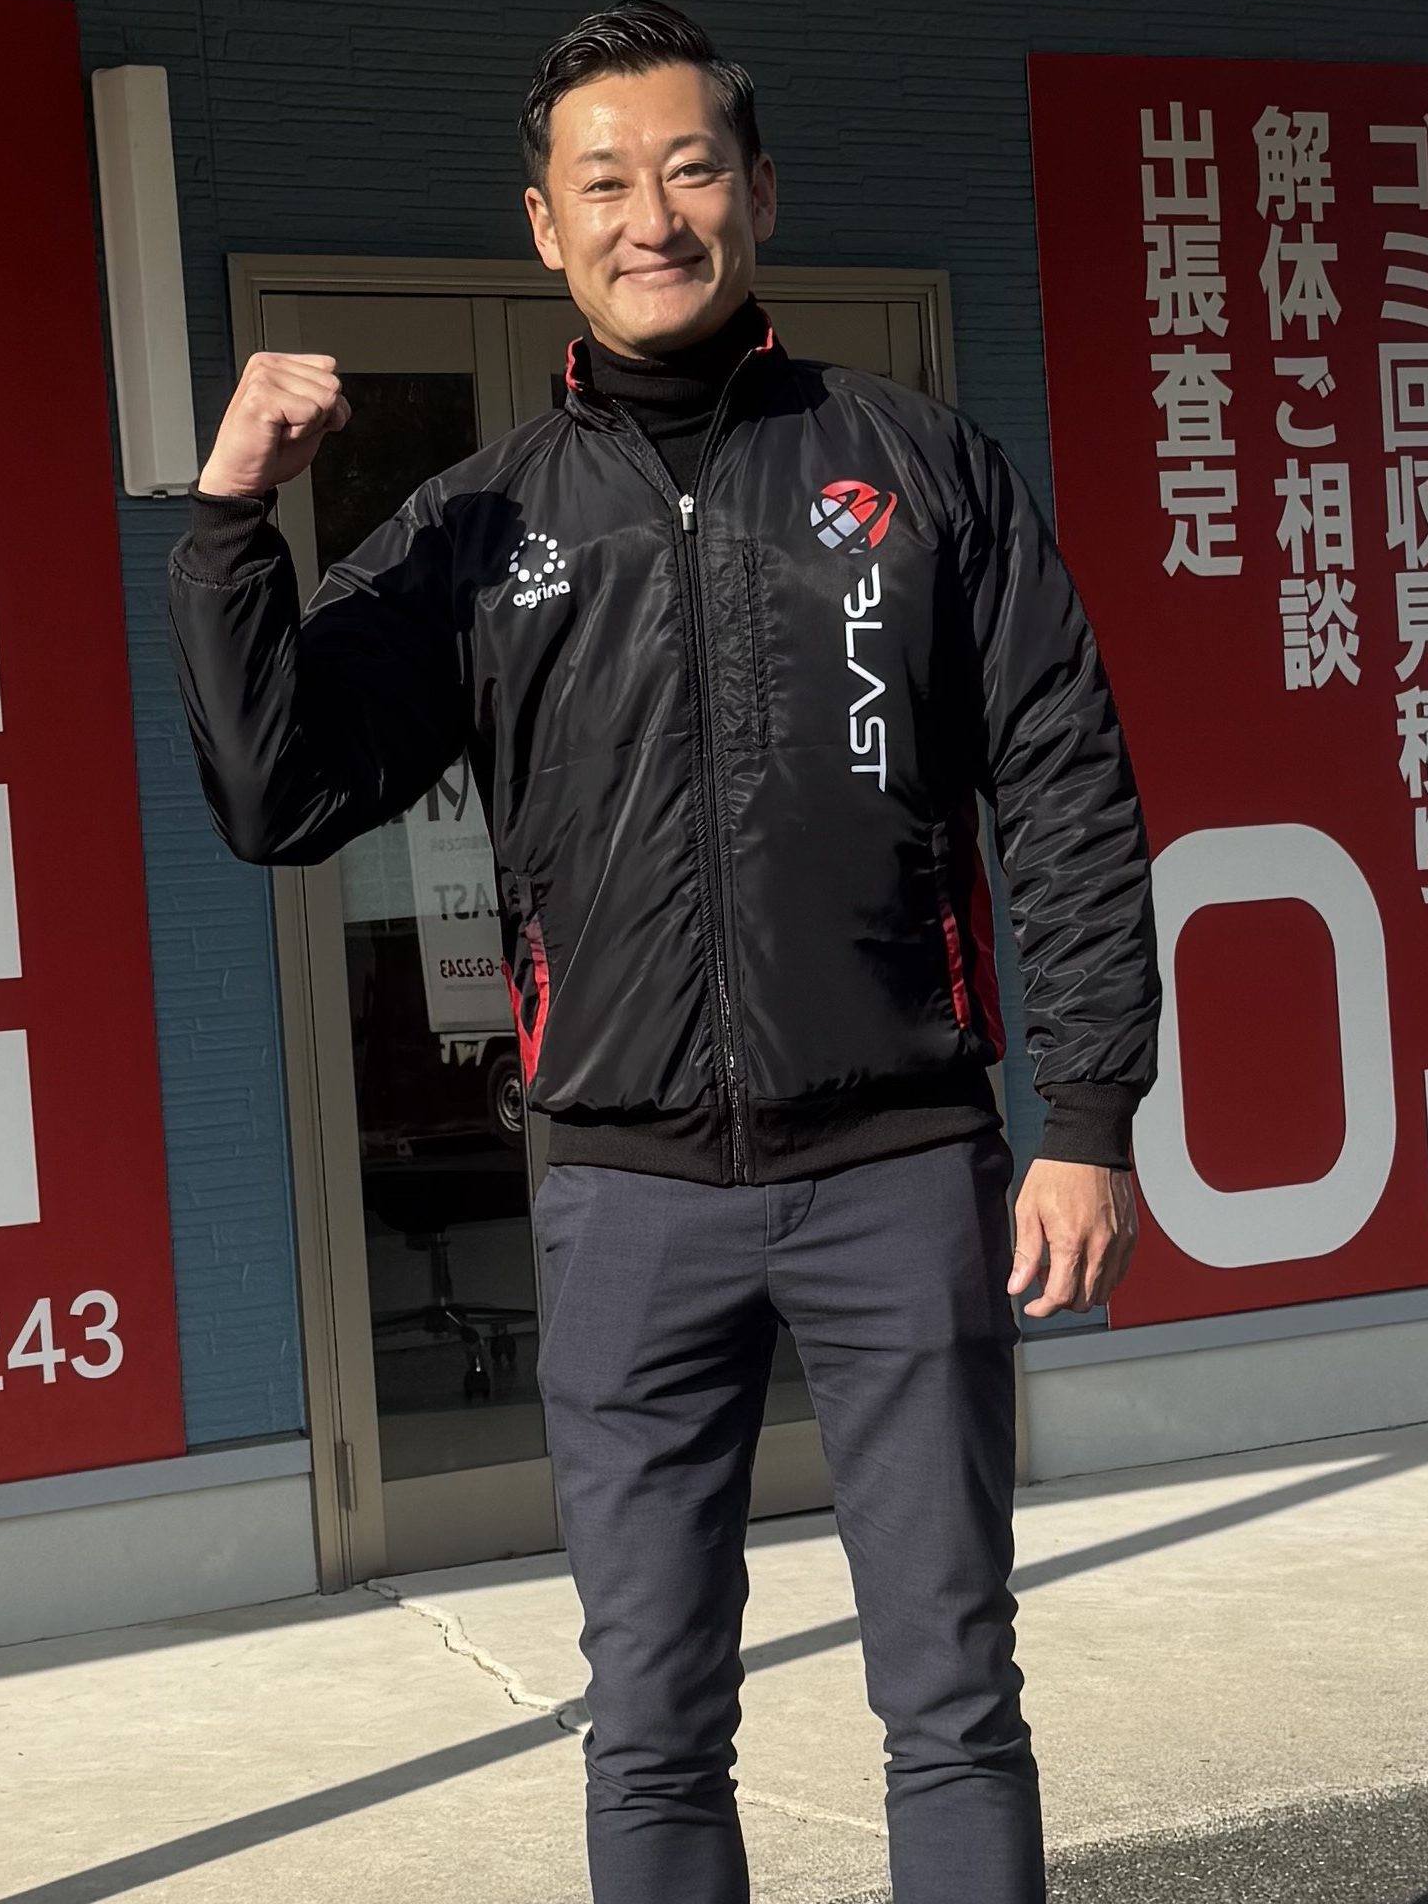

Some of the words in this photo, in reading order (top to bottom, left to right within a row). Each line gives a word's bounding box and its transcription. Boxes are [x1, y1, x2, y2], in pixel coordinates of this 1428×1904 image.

[1140, 101, 1244, 577] 出張査定
[1252, 105, 1362, 691] 解体ご相談
[512, 581, 571, 609] agrina
[843, 562, 887, 793] BLAST
